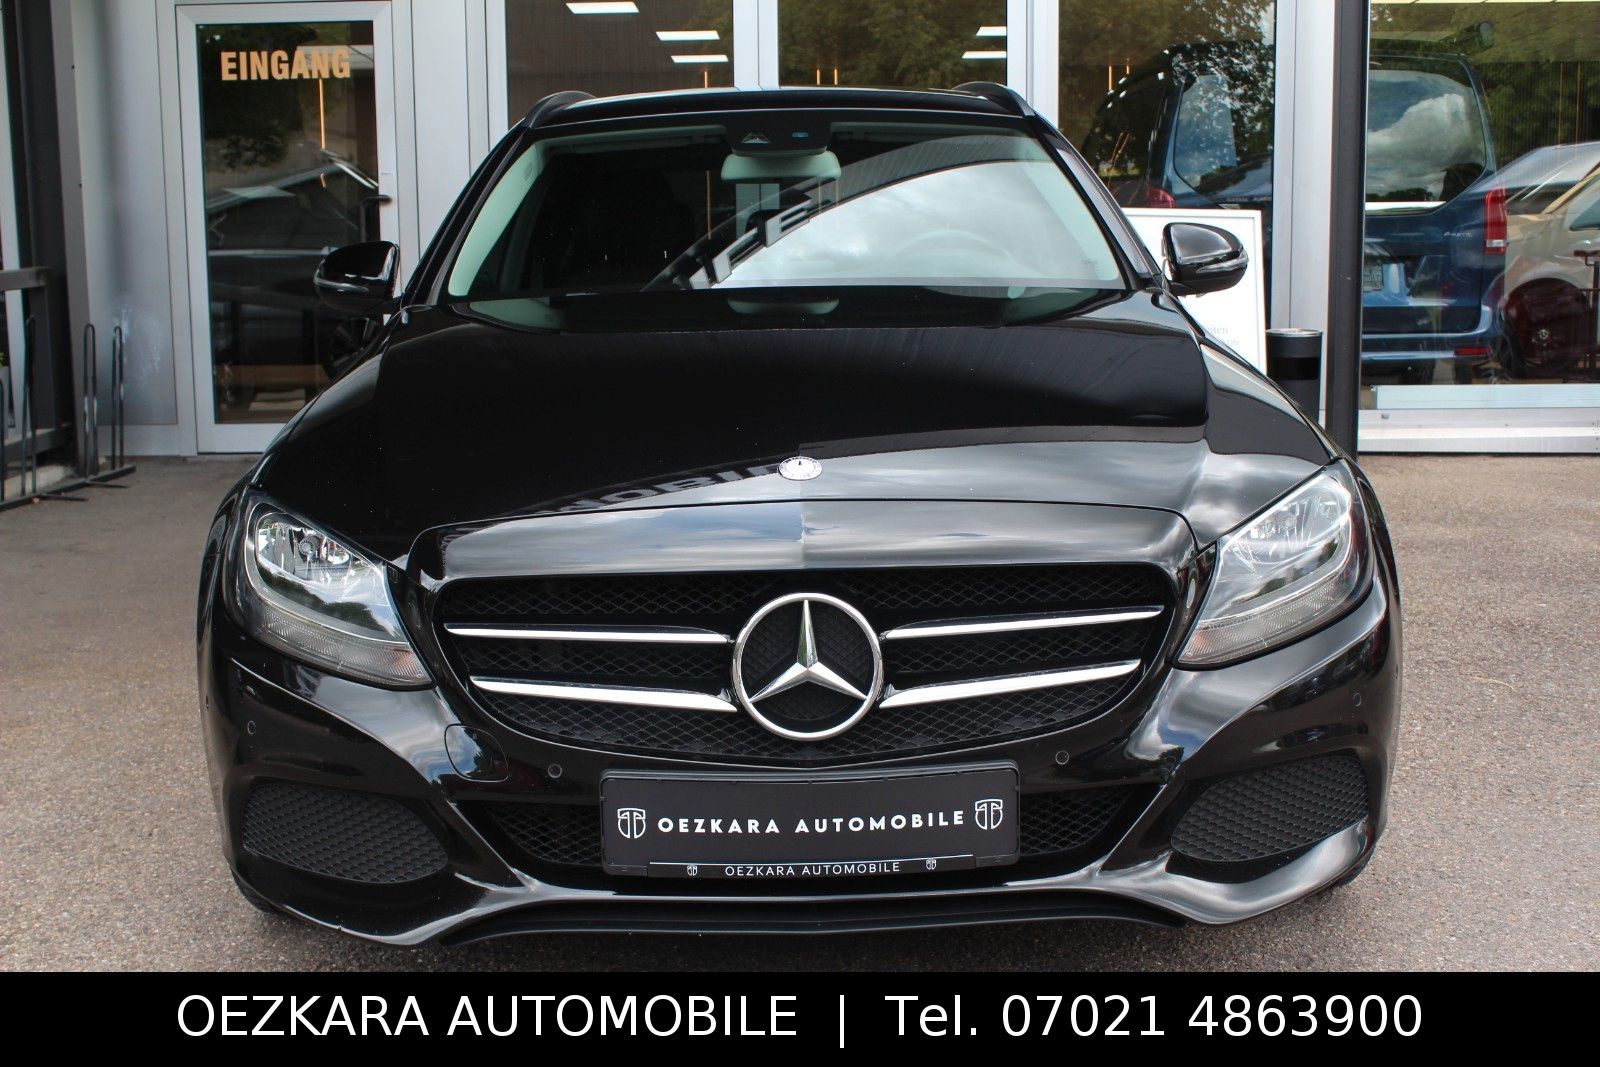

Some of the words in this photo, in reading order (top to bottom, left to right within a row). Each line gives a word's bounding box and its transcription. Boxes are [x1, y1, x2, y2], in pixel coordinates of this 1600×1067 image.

[221, 48, 350, 81] EINGANG
[657, 817, 780, 834] OEZKARA
[794, 810, 965, 834] AUTOMOBILE
[724, 865, 797, 877] OEZKARA
[801, 861, 901, 876] AUTOMOBILE
